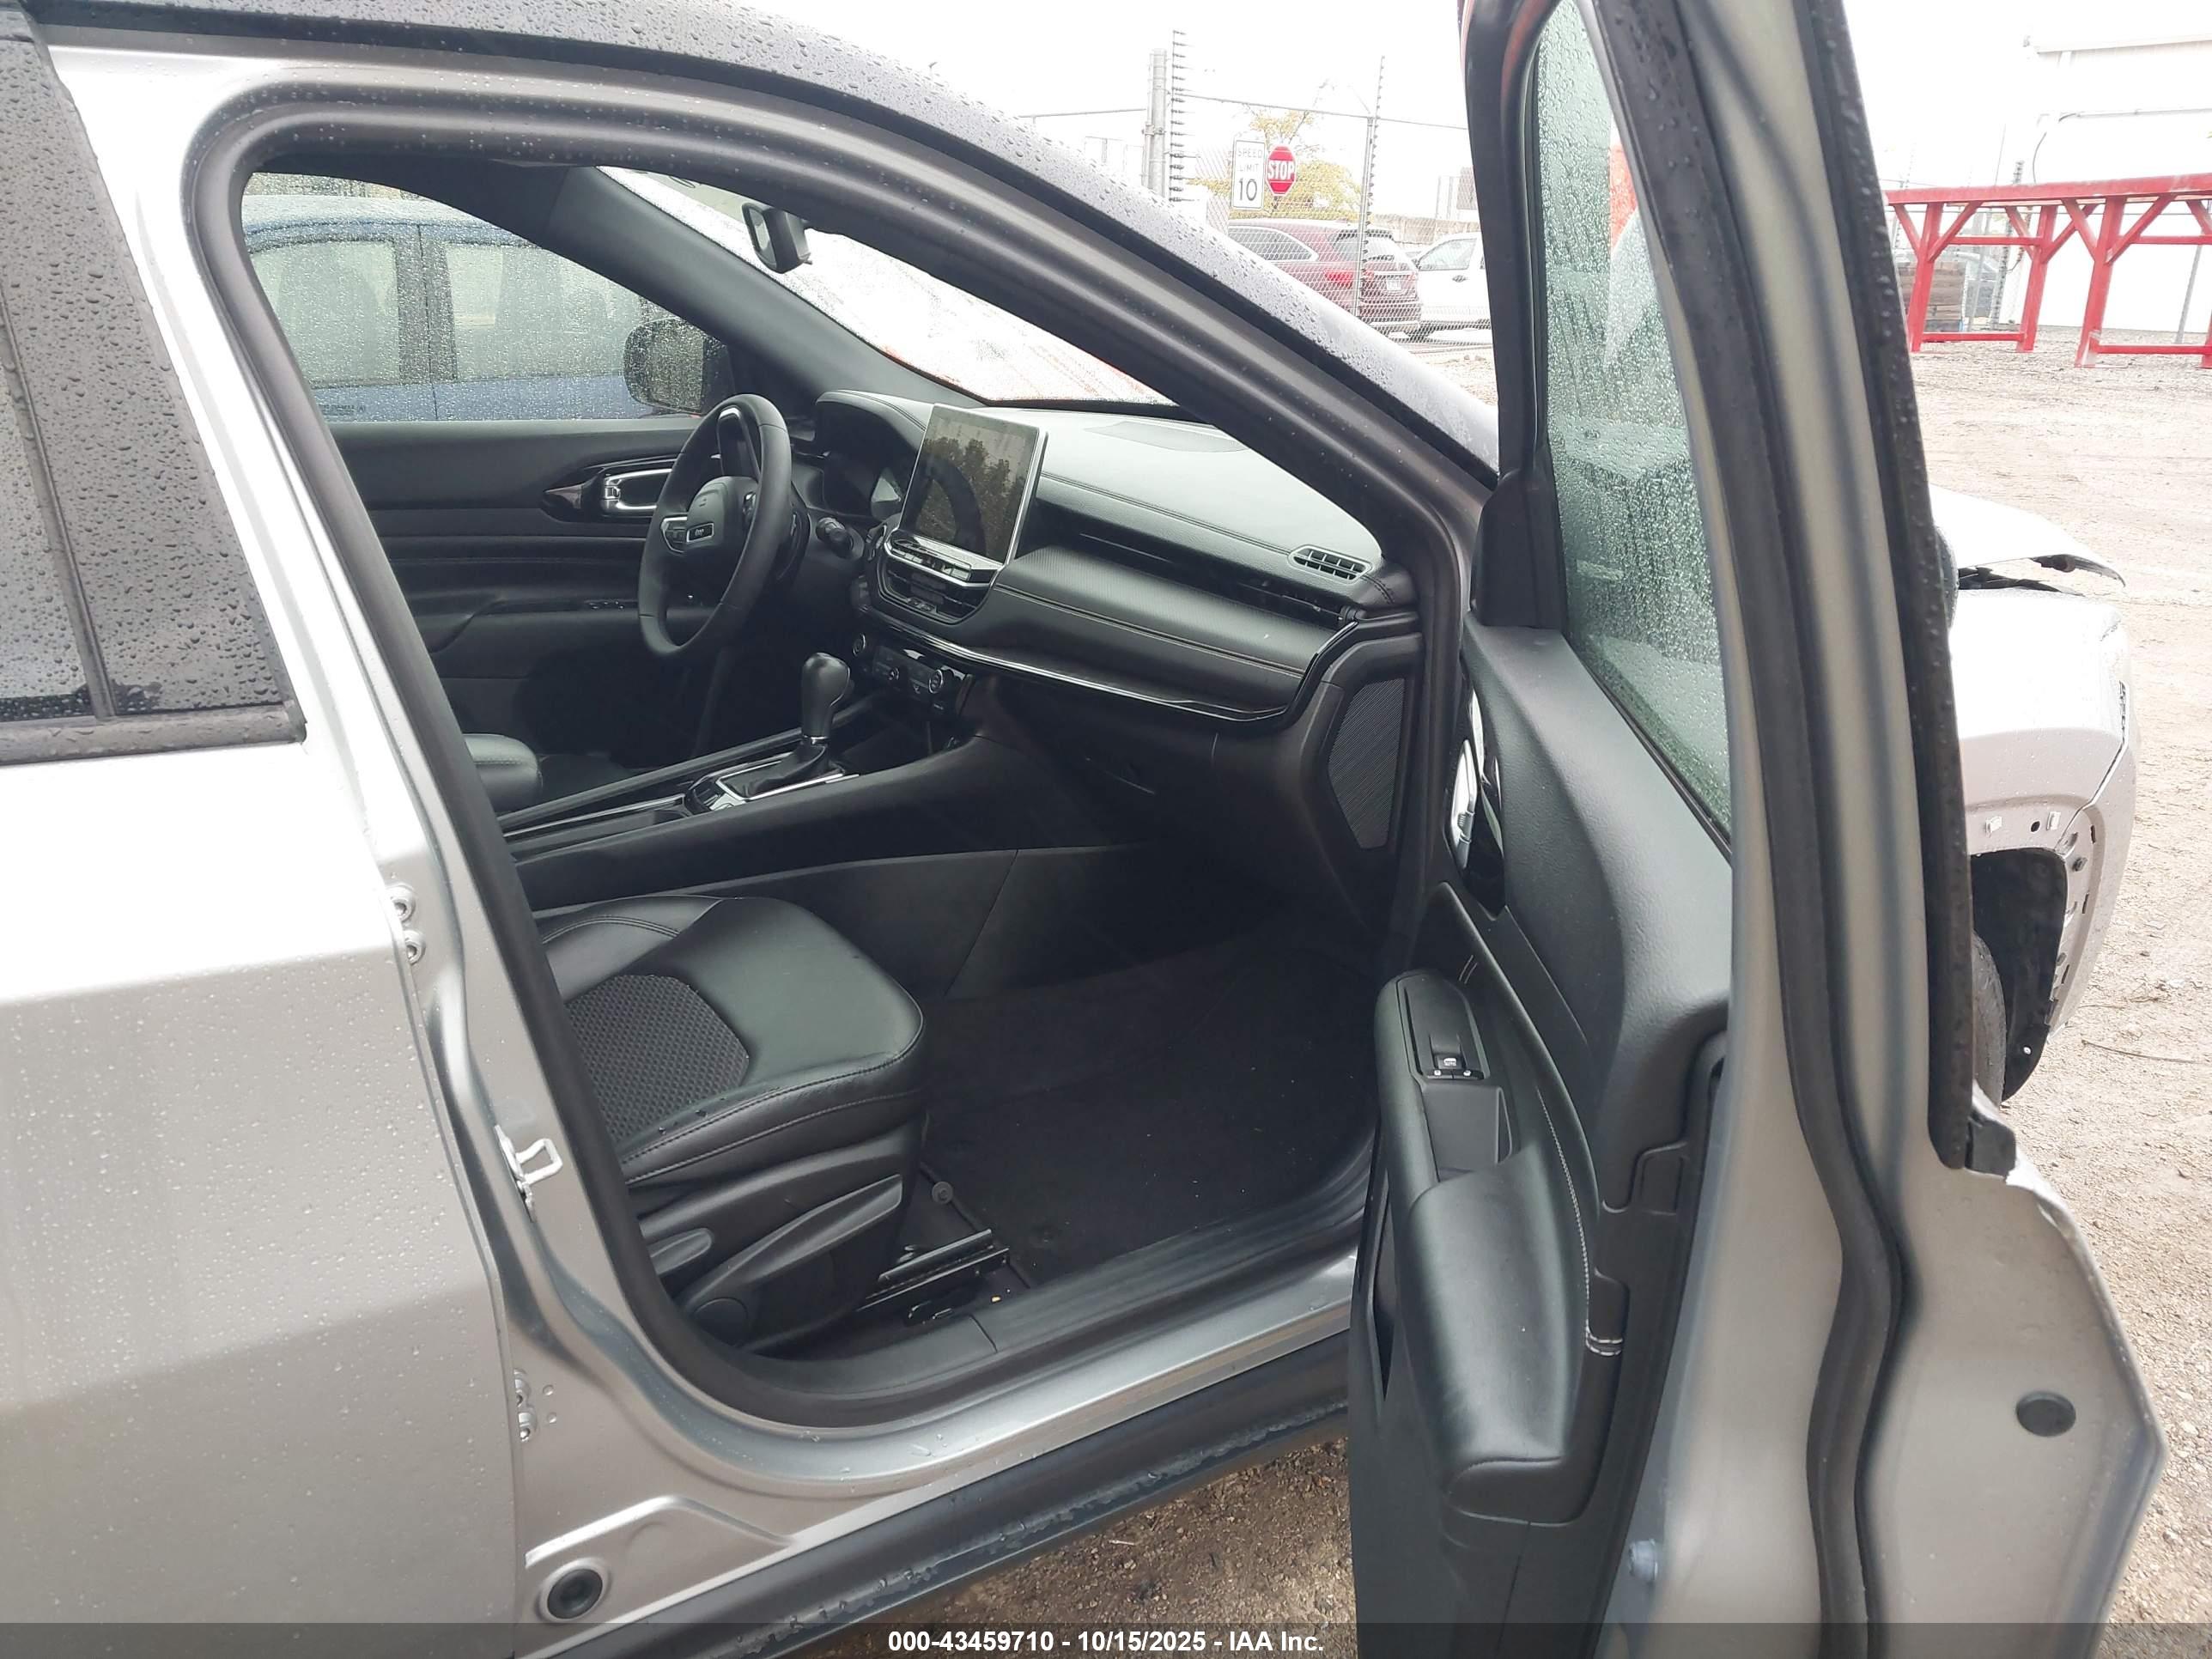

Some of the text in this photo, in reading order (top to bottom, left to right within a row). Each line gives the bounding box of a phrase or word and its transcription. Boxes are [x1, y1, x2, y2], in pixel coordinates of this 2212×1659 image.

[1237, 148, 1262, 158] SPEED
[1239, 163, 1260, 172] LIMIT
[1267, 160, 1295, 180] STOP
[1238, 178, 1258, 201] 10
